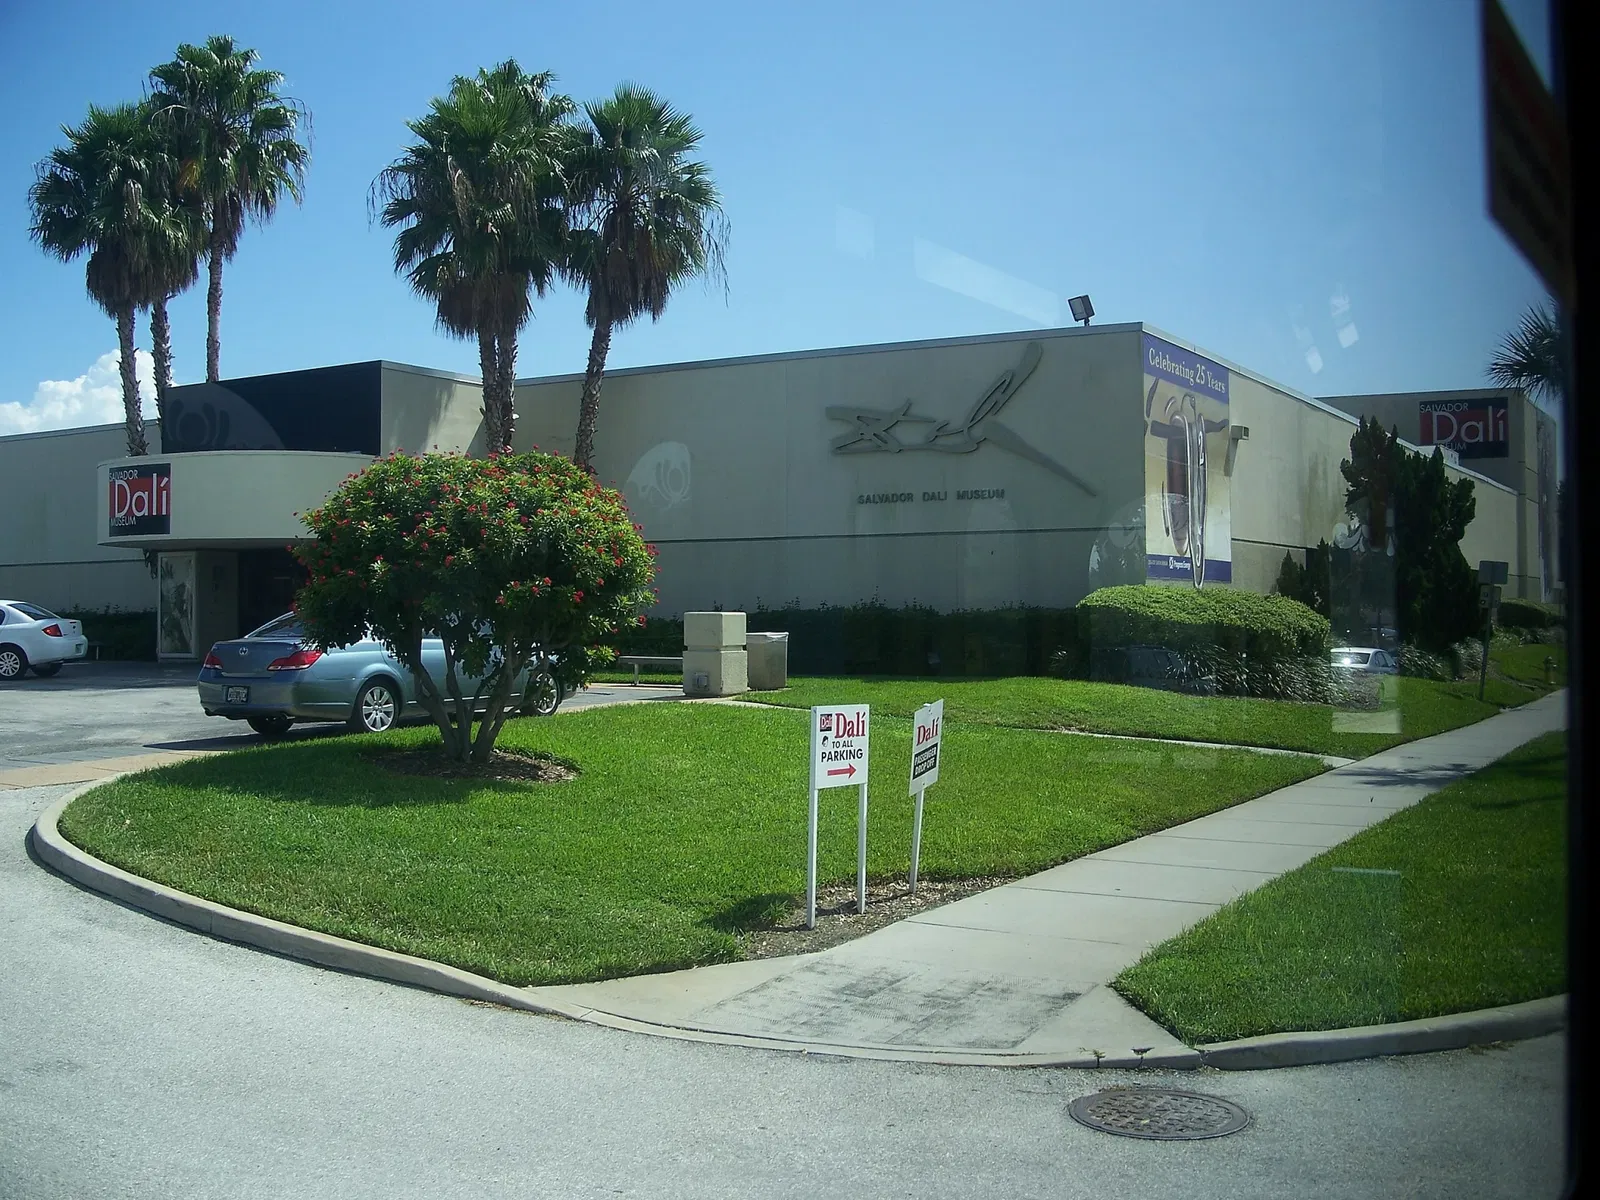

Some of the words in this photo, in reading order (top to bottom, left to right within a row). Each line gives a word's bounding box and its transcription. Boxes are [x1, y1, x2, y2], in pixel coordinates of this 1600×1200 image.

[1148, 348, 1195, 386] Celebrating
[1196, 363, 1206, 384] 25
[1207, 372, 1226, 393] Years
[1420, 402, 1469, 413] SALVADOR
[1433, 405, 1506, 444] Dalí
[115, 473, 169, 518] Dalí
[858, 492, 914, 504] SALVADOR
[923, 491, 948, 502] DALI
[957, 489, 1005, 500] MUSEUM
[834, 711, 866, 739] Dalí
[916, 716, 940, 746] Dalí
[821, 748, 863, 762] PARKING
[832, 741, 841, 749] TO
[842, 740, 854, 748] ALL
